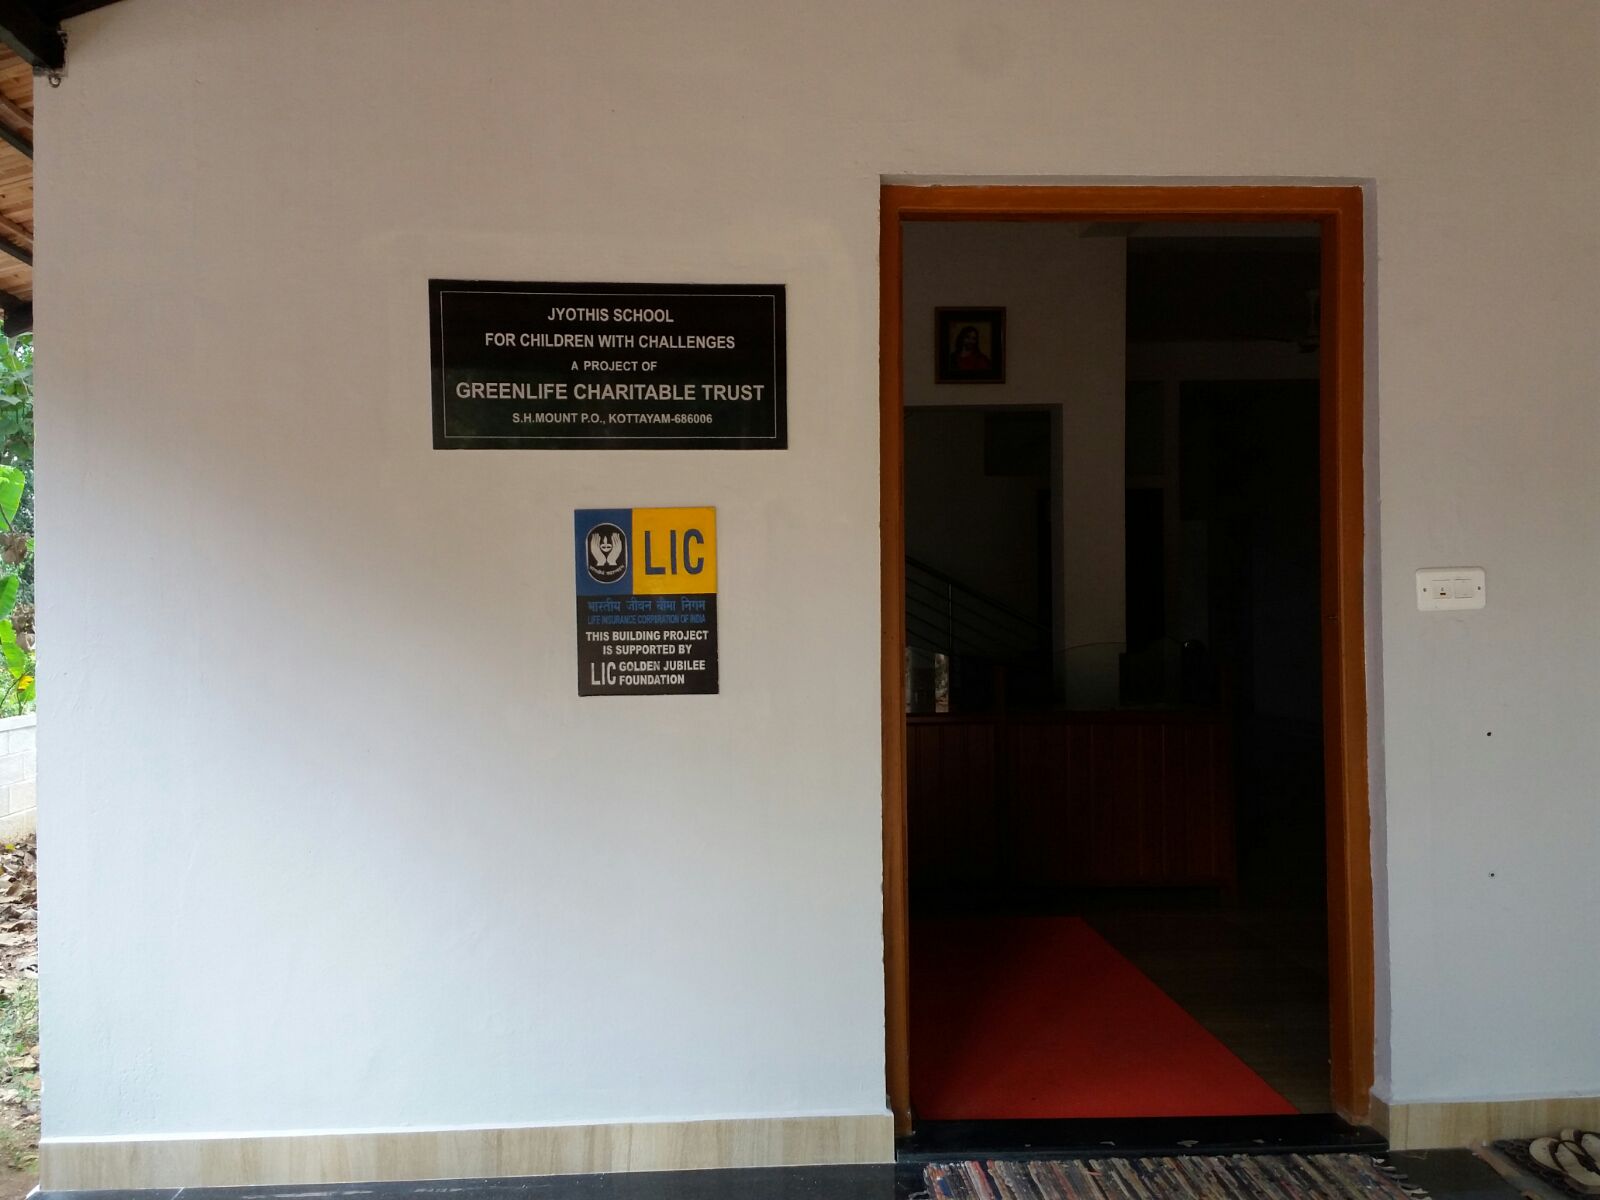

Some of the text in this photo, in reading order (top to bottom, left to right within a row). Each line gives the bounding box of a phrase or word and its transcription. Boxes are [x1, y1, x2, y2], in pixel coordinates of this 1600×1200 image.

[547, 307, 674, 323] JYOTHIS SCHOOL
[485, 332, 735, 349] FOR CHILDREN WITH CHALLENGES
[571, 361, 658, 372] A PROJECT OF
[455, 382, 765, 401] GREENLIFE CHARITABLE TRUST
[512, 413, 713, 425] S.H.MOUNT P.O., KOTTAYAM-686006
[644, 528, 704, 575] LIC
[587, 596, 706, 612] भारतीय जीवन बीमा निगम
[587, 615, 600, 624] LIFE
[601, 615, 636, 624] INSURANCE
[638, 614, 679, 624] CORPORATION
[586, 630, 709, 641] THIS BUILDING PROJECT
[603, 644, 692, 655] IS SUPPORTED BY
[619, 660, 706, 672] GOLDEN JUBILEE
[590, 662, 616, 686] LIC
[619, 674, 685, 686] FOUNDATION
